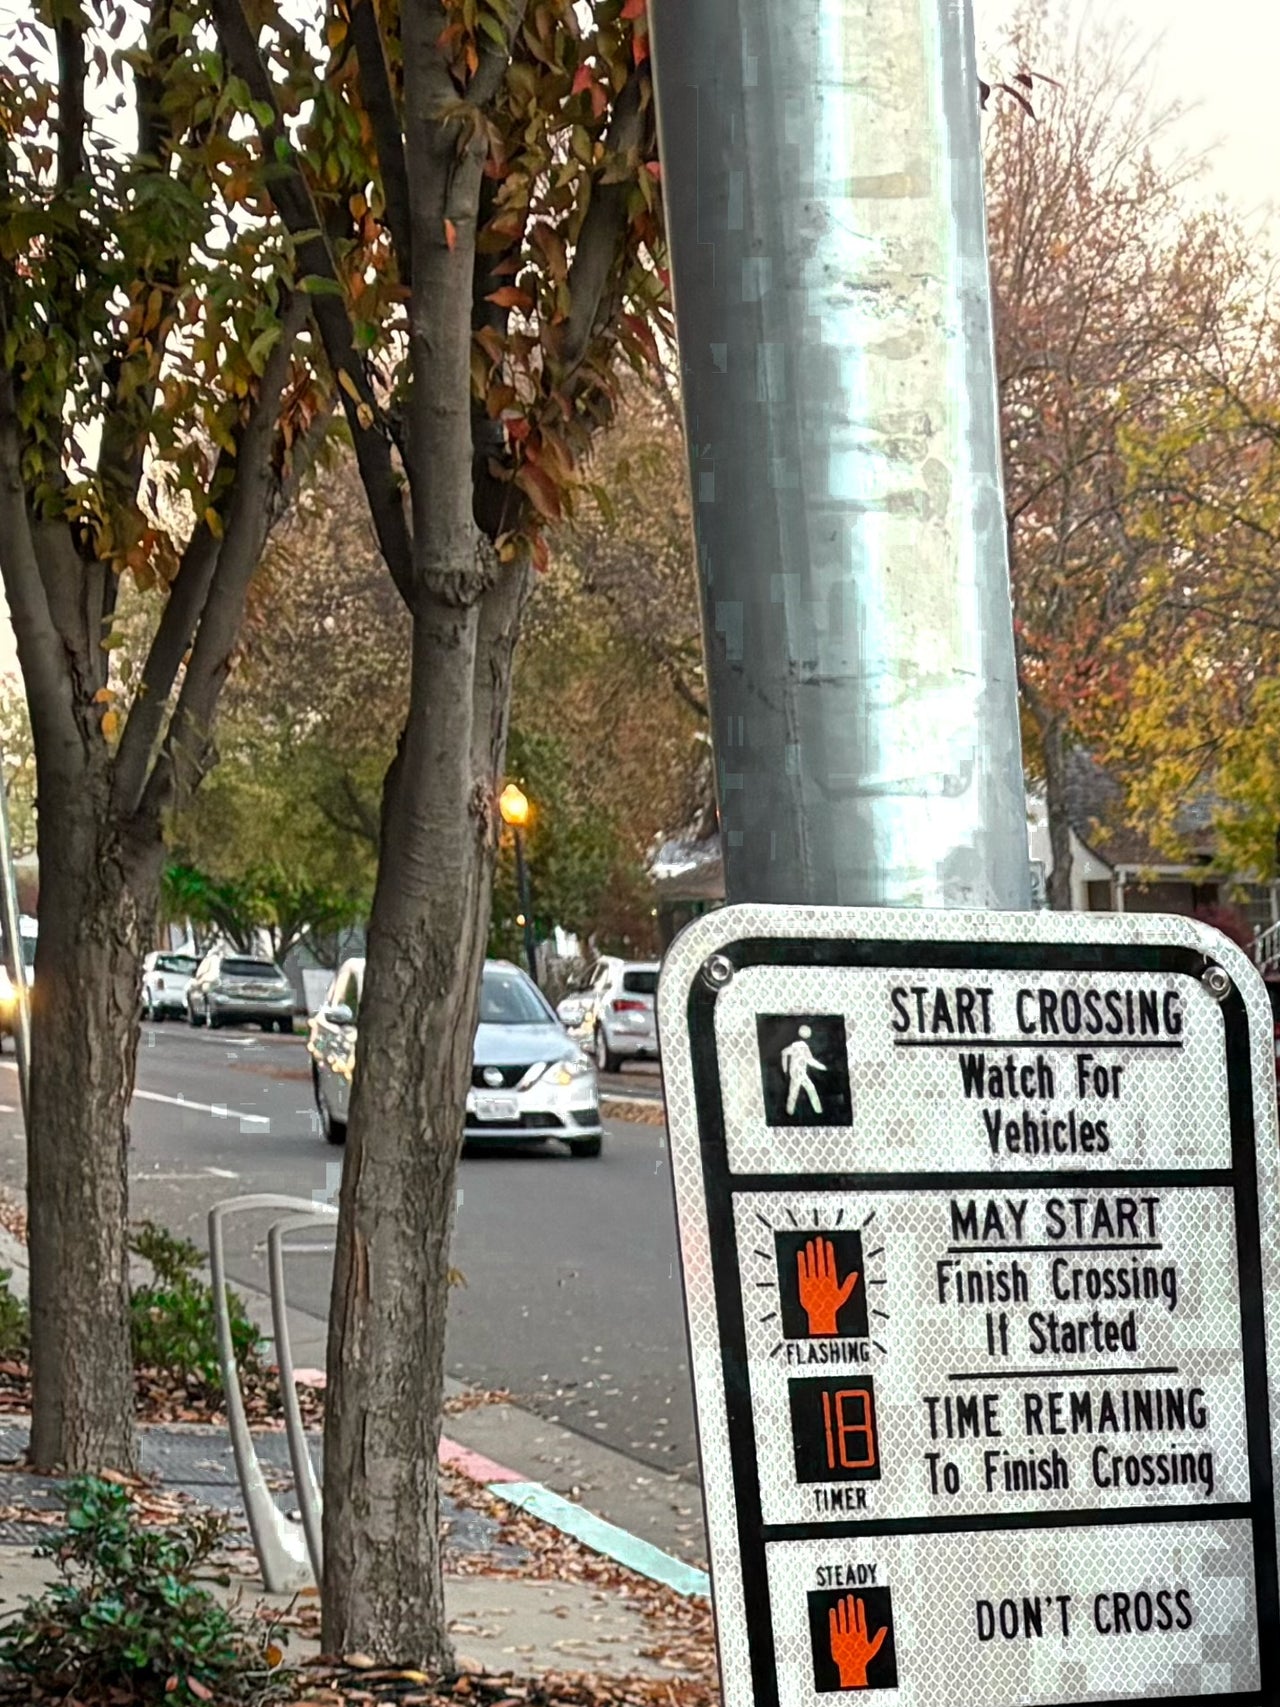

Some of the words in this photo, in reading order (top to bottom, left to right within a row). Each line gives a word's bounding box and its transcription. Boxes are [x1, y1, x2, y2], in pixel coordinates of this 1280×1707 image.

[890, 986, 994, 1034] START
[1016, 988, 1183, 1036] CROSSING
[958, 1053, 1055, 1099] Watch
[1076, 1053, 1124, 1099] For
[982, 1108, 1110, 1155] Vehicles
[950, 1199, 1028, 1242] MAY
[1045, 1196, 1161, 1241] START
[936, 1259, 1029, 1304] Finish
[1051, 1257, 1178, 1313] Crossing
[786, 1341, 870, 1365] FLASHING
[985, 1311, 1009, 1356] If
[1028, 1309, 1138, 1355] Started
[922, 1393, 1002, 1441] TIME
[1023, 1387, 1207, 1436] REMAINING
[923, 1452, 960, 1495] To
[983, 1448, 1070, 1493] Finish
[1092, 1444, 1215, 1498] Crossing
[813, 1487, 867, 1512] TIMER
[816, 1563, 877, 1587] STEADY
[976, 1594, 1072, 1642] DON'T
[1093, 1588, 1193, 1635] CROSS
